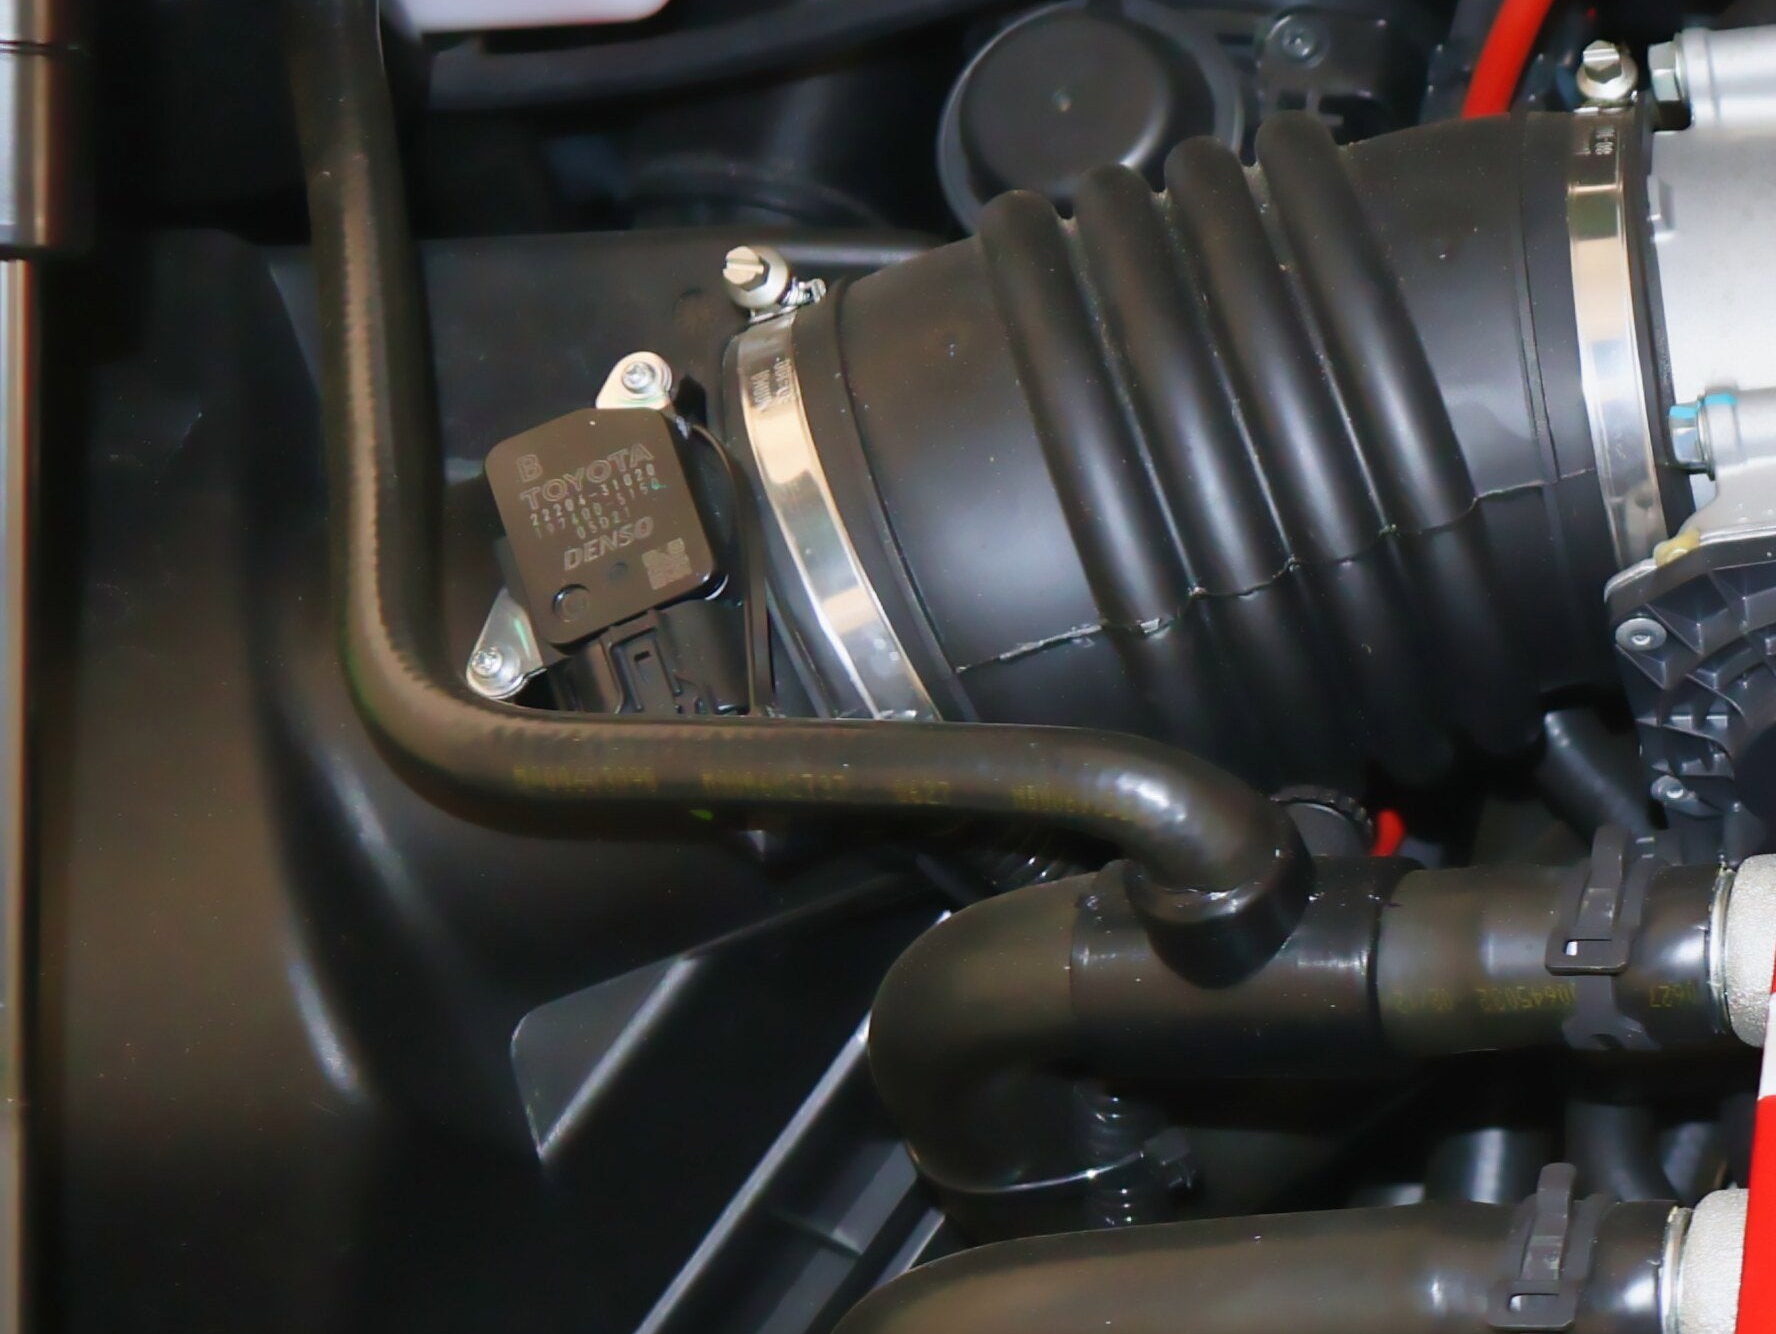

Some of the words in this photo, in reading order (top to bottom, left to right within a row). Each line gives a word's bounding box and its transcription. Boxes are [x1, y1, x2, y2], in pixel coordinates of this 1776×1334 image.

[516, 453, 544, 484] B
[519, 443, 655, 511] TOYOTA
[530, 463, 656, 527] 22204-31020
[563, 516, 655, 572] DENSO
